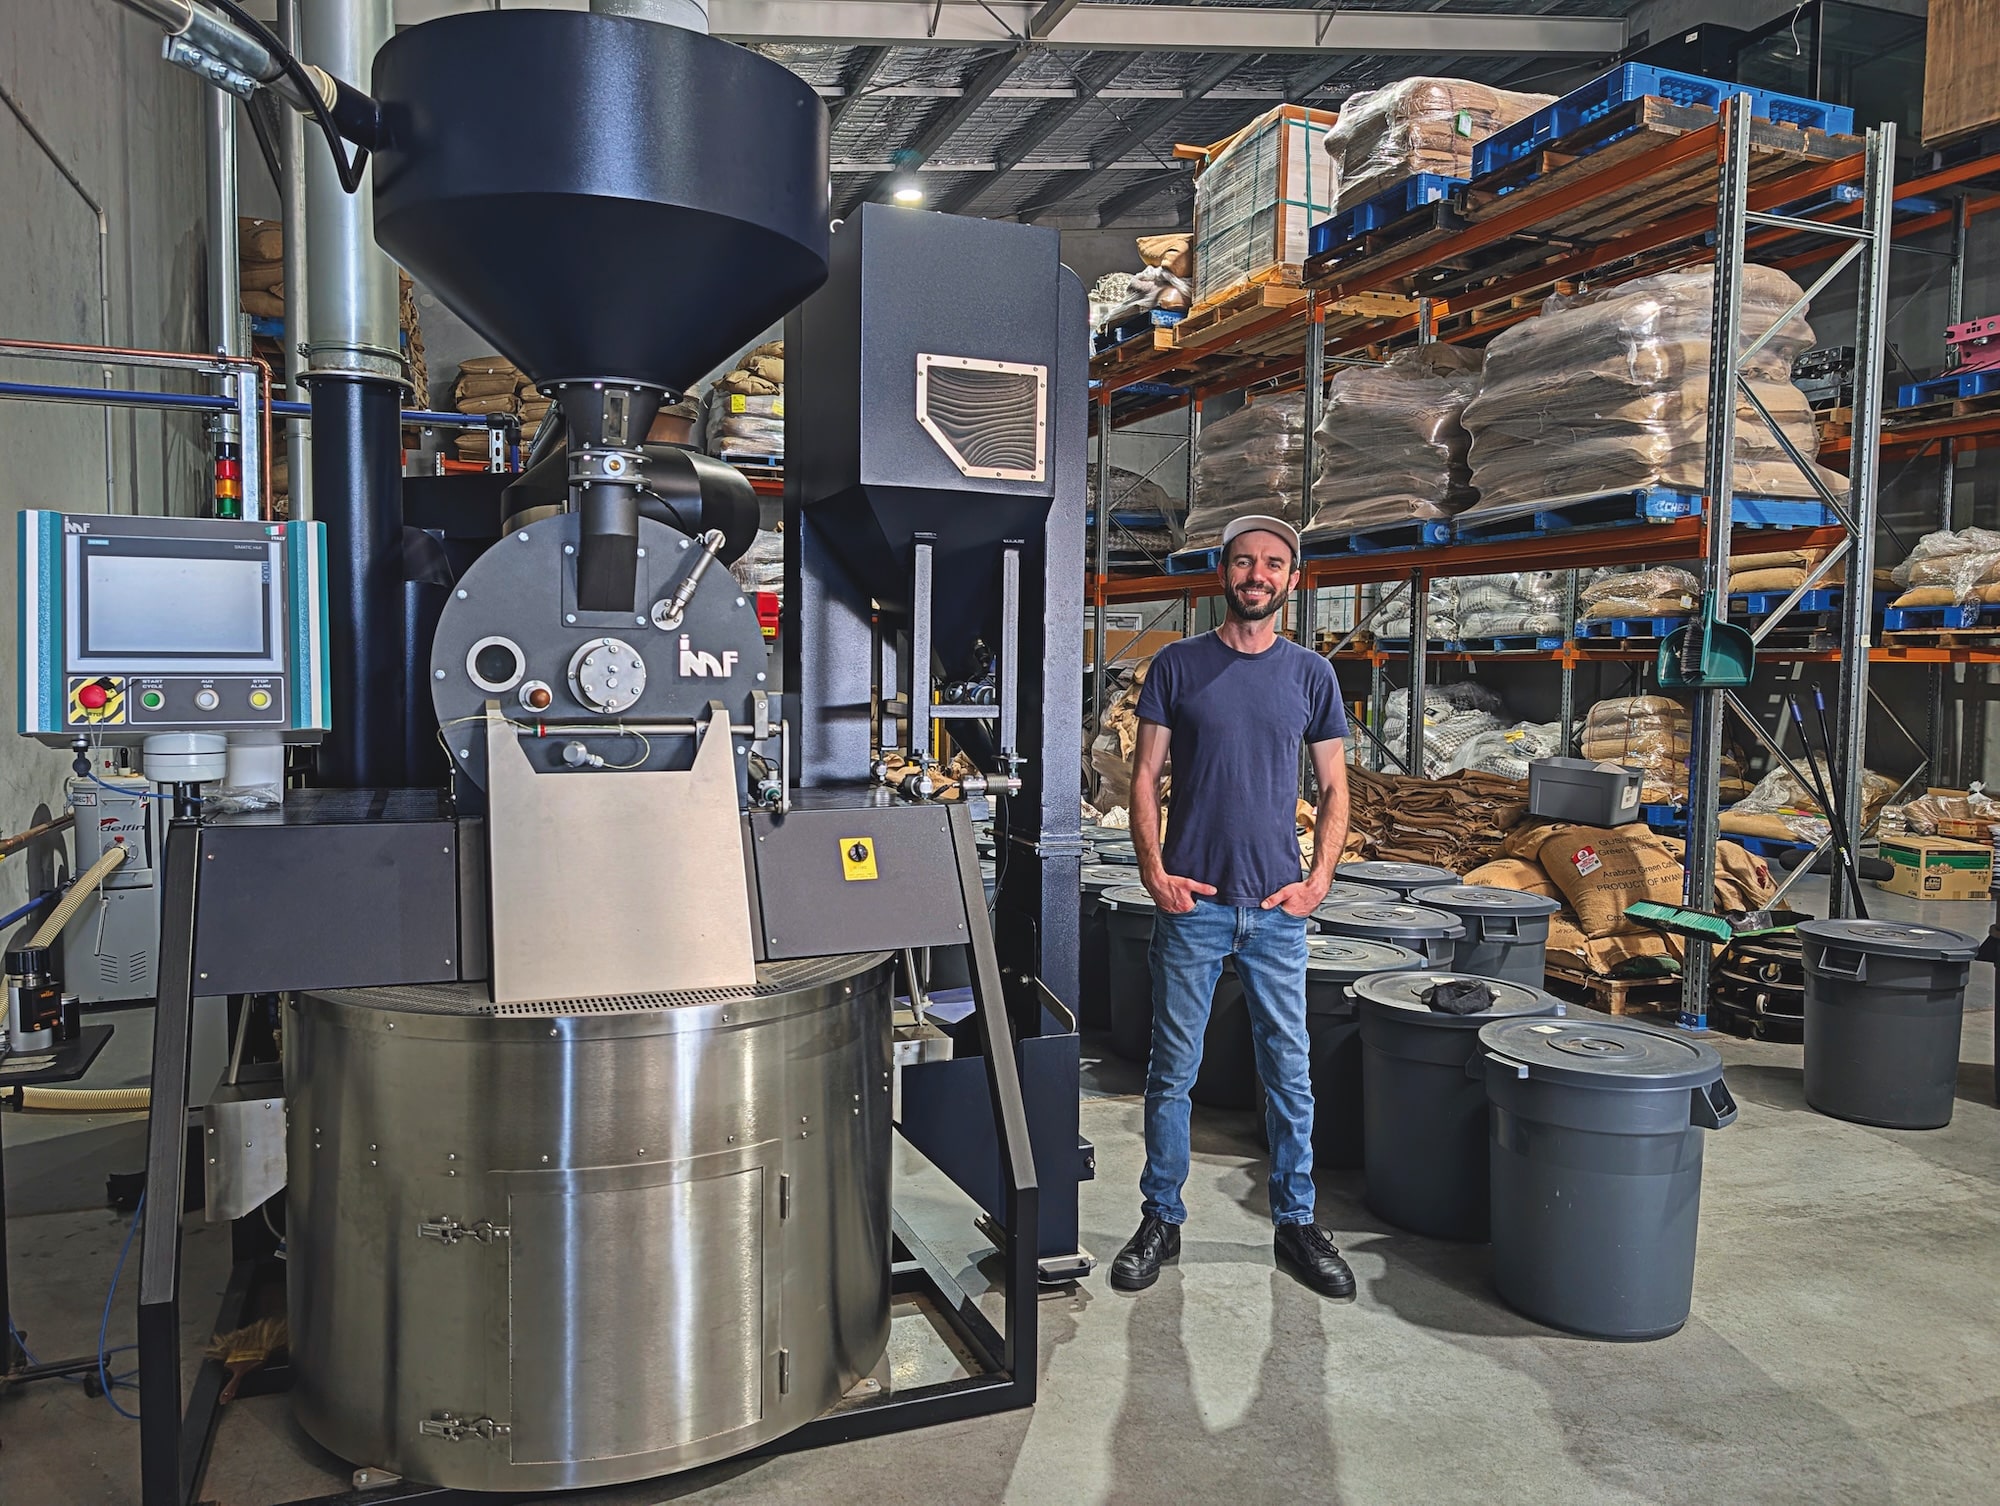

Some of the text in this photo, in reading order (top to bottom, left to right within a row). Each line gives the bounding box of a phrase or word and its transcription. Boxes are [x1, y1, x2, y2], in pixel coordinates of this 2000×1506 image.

[1598, 846, 1627, 856] Green
[1603, 868, 1637, 879] Arabica
[1638, 863, 1662, 874] Green
[1597, 879, 1646, 892] PRODUCT
[1648, 878, 1659, 886] OF
